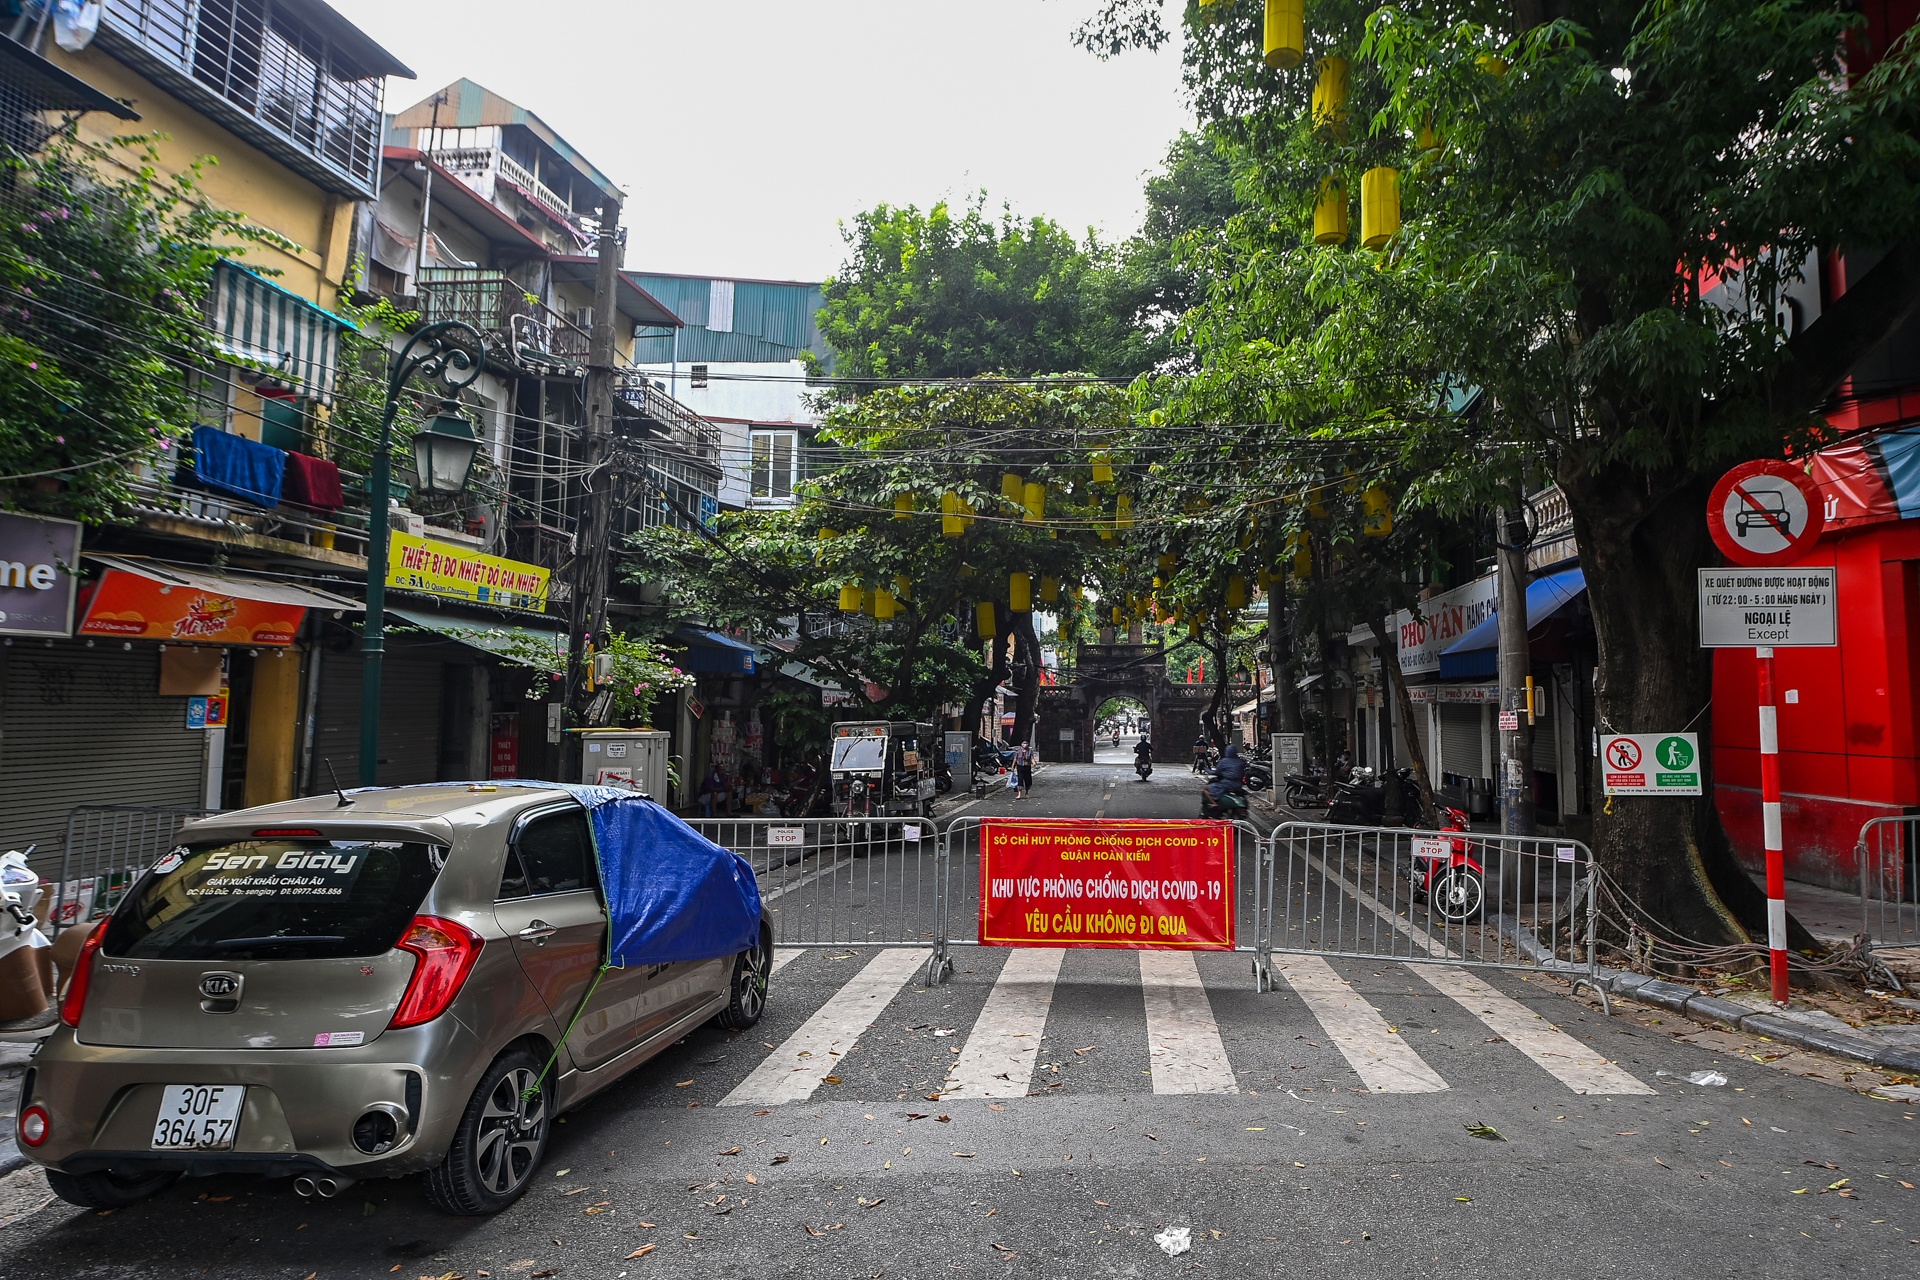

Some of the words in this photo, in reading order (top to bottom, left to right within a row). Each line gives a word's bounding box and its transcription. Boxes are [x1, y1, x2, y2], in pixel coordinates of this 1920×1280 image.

[401, 543, 431, 571] THIẾT
[432, 554, 442, 579] BỊ
[444, 557, 457, 577] ĐO
[459, 560, 486, 586] NHIỆT
[487, 564, 500, 590] ĐỘ
[501, 570, 514, 588] GIA
[408, 574, 424, 588] 5A
[1705, 578, 1714, 588] XE
[1716, 576, 1734, 588] QUÉT
[1737, 575, 1762, 588] ĐƯỜNG
[1764, 577, 1784, 589] ĐƯỢC
[1787, 577, 1806, 589] HOẠT
[1808, 575, 1830, 589] ĐỘNG
[1777, 592, 1798, 604] HÀNG
[1800, 592, 1820, 604] NGÀY
[1430, 602, 1463, 641] VÂN
[1467, 599, 1484, 630] HÀNG
[1745, 612, 1775, 627] NGOẠI
[1780, 610, 1791, 627] LỆ
[1748, 628, 1789, 642] Except
[1465, 688, 1484, 698] VÂN
[994, 833, 1008, 845] SỞ
[1010, 833, 1028, 845] CHỈ
[1031, 836, 1051, 845] HUY
[1054, 834, 1091, 845] PHÒNG
[1094, 834, 1132, 846] CHỐNG
[1136, 838, 1162, 848] DỊCH
[1164, 838, 1198, 846] COVID
[1207, 838, 1218, 847] 19
[202, 852, 269, 871] Sen
[1061, 850, 1090, 863] QUẬN
[1093, 850, 1124, 861] HOÀN
[1126, 849, 1150, 861] KIẾM
[207, 875, 229, 885] GIẤY
[229, 875, 253, 885] XUẤT
[253, 874, 279, 885] KHẨU
[280, 876, 309, 885] CHÂU
[309, 876, 325, 885] ÂU
[245, 888, 277, 896] sengiay
[992, 879, 1014, 898] KHU
[1017, 875, 1040, 903] VỰC
[1043, 873, 1083, 898] PHÒNG
[1086, 870, 1128, 898] CHỐNG
[1131, 880, 1159, 905] DỊCH
[1162, 880, 1198, 900] COVID
[1208, 881, 1221, 900] 19
[1025, 908, 1048, 933] YÊU
[1052, 904, 1081, 933] CẦU
[1086, 909, 1136, 934] KHÔNG
[1140, 915, 1154, 934] ĐI
[1158, 916, 1187, 935] QUA
[205, 980, 230, 992] KIA
[178, 1088, 224, 1115] 30F
[155, 1119, 233, 1146] 364.57
